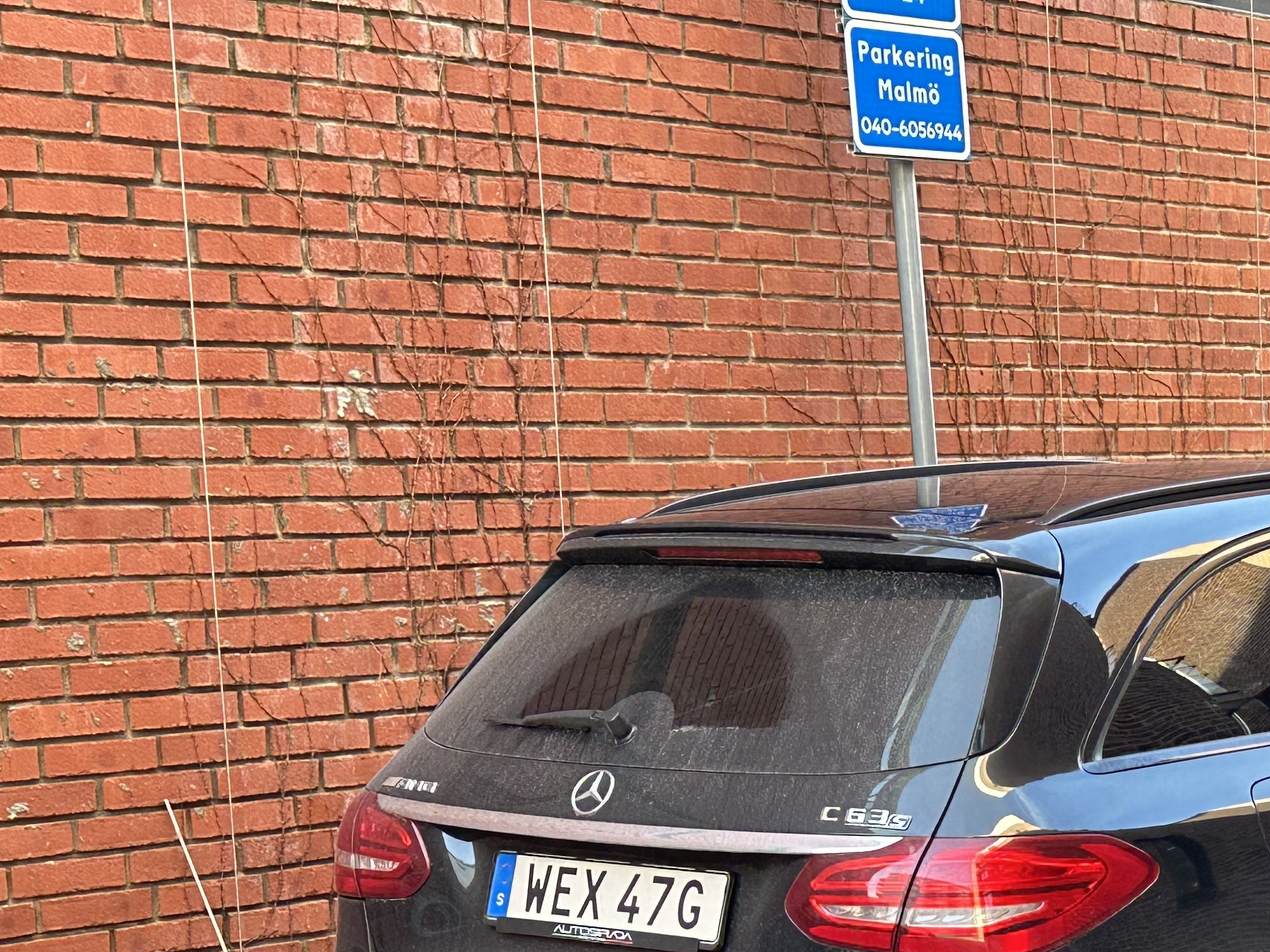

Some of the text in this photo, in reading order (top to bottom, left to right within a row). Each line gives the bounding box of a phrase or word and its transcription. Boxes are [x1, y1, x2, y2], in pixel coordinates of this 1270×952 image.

[857, 40, 954, 77] Parkering
[878, 78, 940, 105] Malmö
[861, 116, 963, 141] 040-6056944
[820, 806, 841, 821] C
[496, 892, 505, 906] S
[524, 863, 704, 930] WEX 47G
